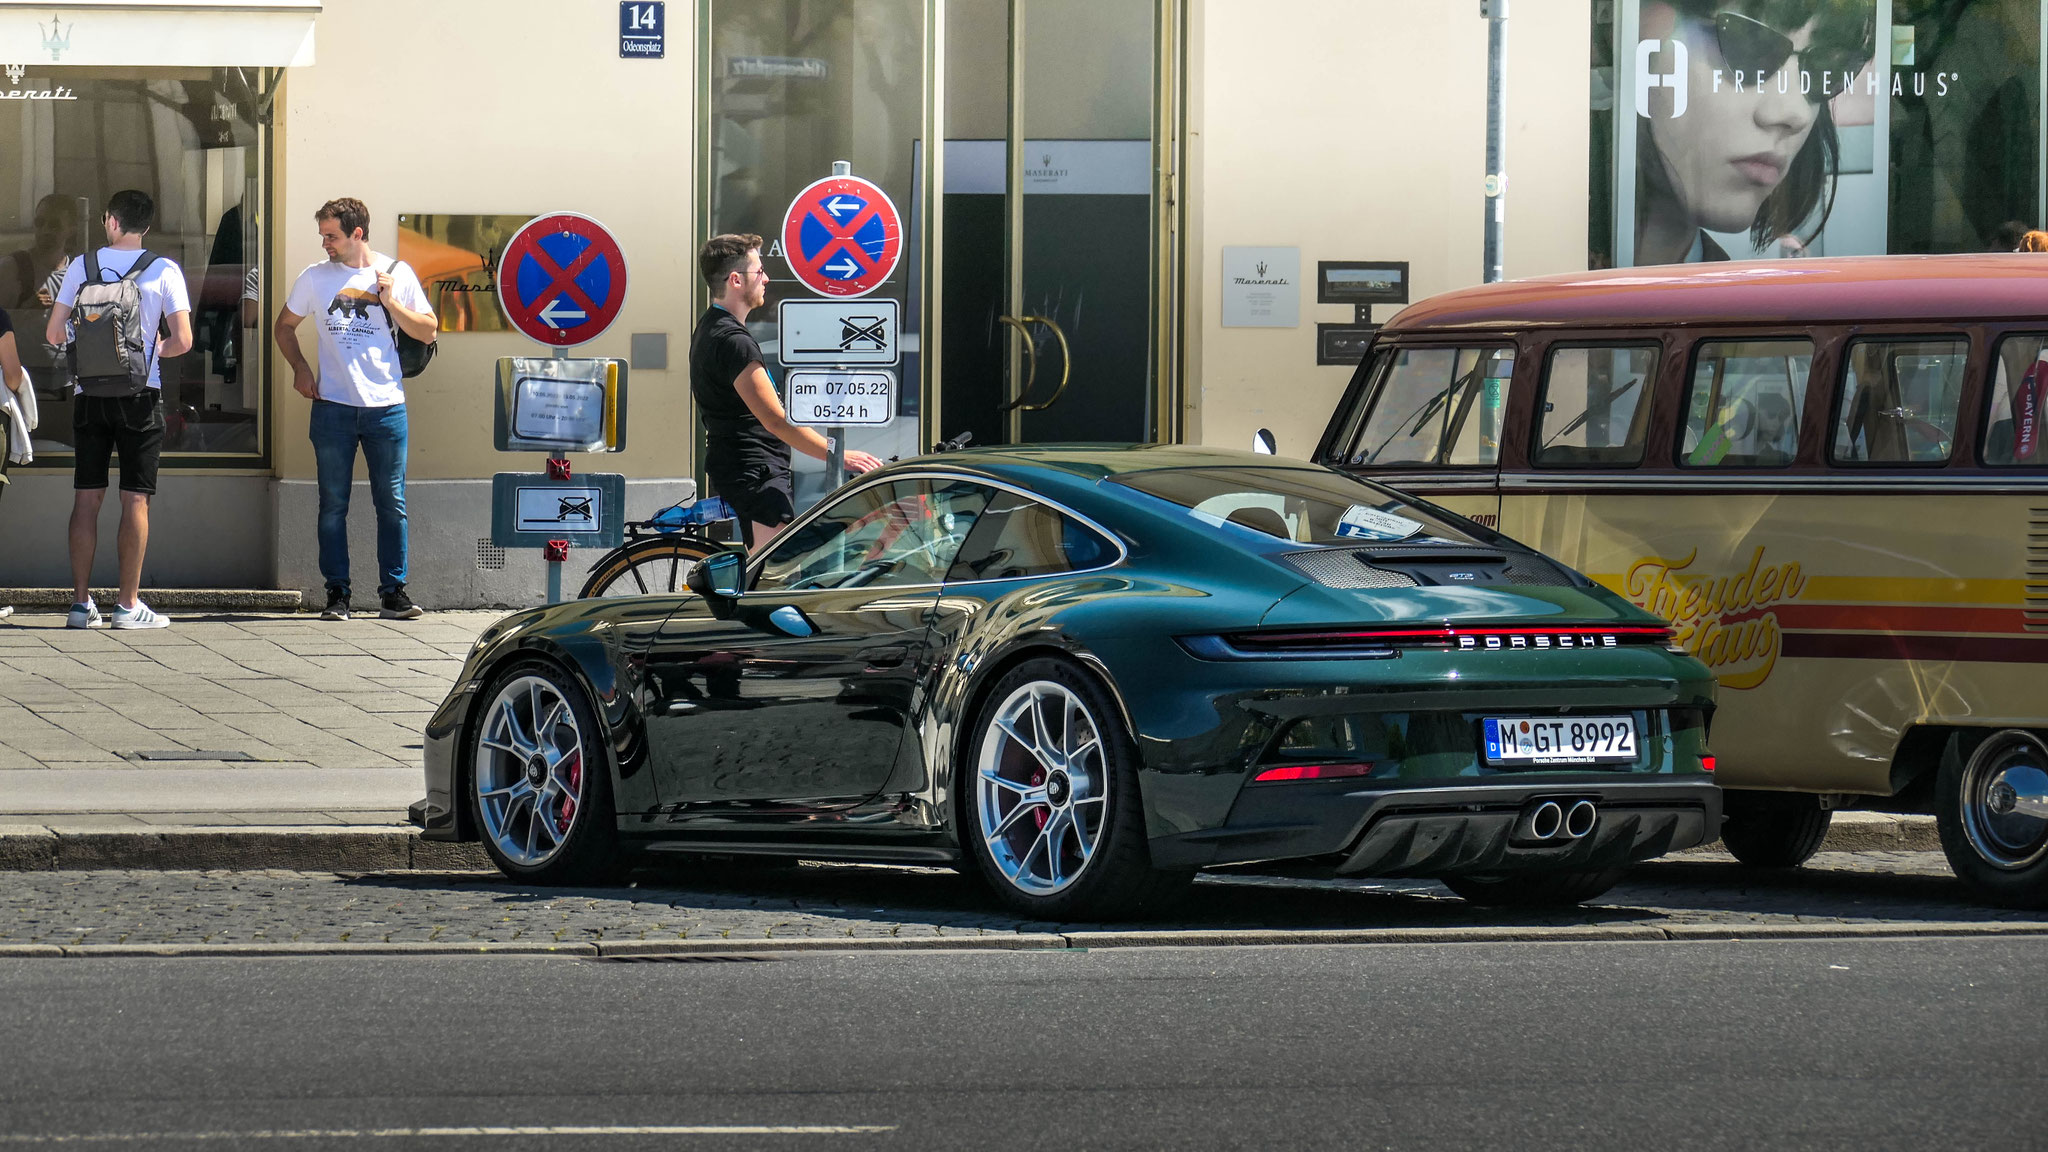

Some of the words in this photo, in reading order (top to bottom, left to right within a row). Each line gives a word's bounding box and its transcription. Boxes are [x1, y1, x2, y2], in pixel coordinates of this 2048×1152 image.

[628, 4, 656, 30] 14
[622, 40, 662, 55] Odeonsplatz
[1025, 169, 1068, 177] MASERATI
[435, 280, 498, 292] Mase
[1233, 277, 1290, 285] Maserati
[352, 327, 374, 335] CANADA
[795, 384, 817, 395] am
[826, 382, 888, 395] 07.05.22
[814, 405, 854, 418] 05-24
[859, 405, 868, 418] h
[1627, 545, 1805, 622] Freuden
[1459, 635, 1617, 648] PORSCHE
[1490, 742, 1497, 752] D
[1500, 723, 1518, 754] M
[1533, 722, 1564, 752] GT
[1570, 722, 1632, 752] 8992
